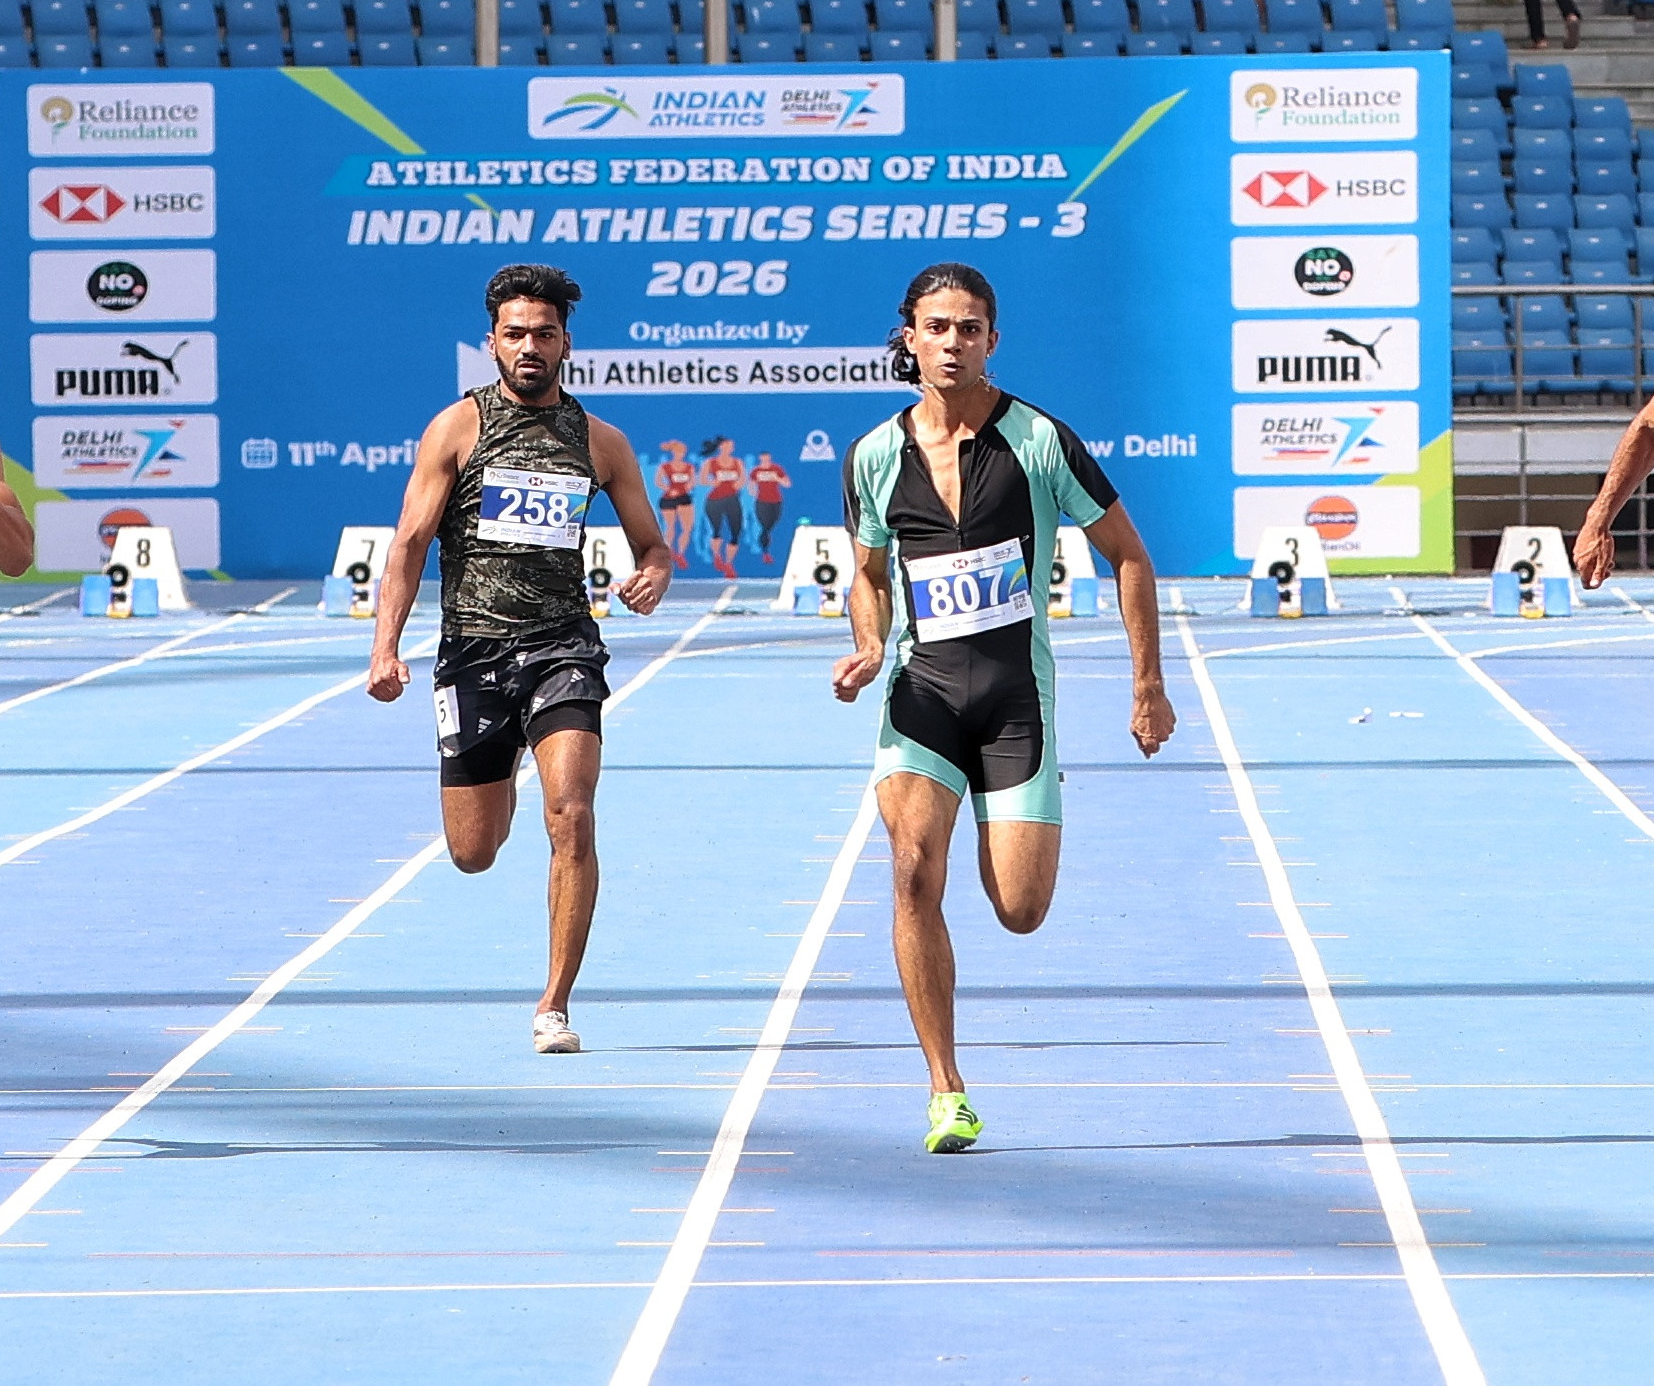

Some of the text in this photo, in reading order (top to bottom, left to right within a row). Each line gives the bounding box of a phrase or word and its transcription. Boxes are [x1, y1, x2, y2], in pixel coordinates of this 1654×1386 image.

[653, 91, 767, 110] INDIAN
[780, 89, 831, 103] DELHI
[1282, 86, 1401, 108] Reliance
[79, 99, 199, 123] Reliance
[649, 112, 766, 127] ATHLETICS
[1281, 109, 1401, 127] Foundation
[79, 123, 198, 141] Foundation
[366, 153, 1068, 187] ATHLETICS FEDERATION OF INDIA
[1336, 179, 1407, 198] HSBC
[133, 193, 205, 214] HSBC
[347, 201, 1088, 246] INDIAN ATHLETICS SERIES - 3
[645, 260, 789, 297] 2026
[1304, 259, 1341, 277] NO
[99, 273, 135, 291] NO
[629, 320, 811, 348] Organized by
[561, 359, 594, 385] lhi
[604, 357, 740, 385] Athletics
[1257, 355, 1361, 383] PUMA
[56, 368, 160, 397] PUMA
[62, 429, 124, 445] DELHI
[1261, 417, 1324, 432] DELHI
[62, 445, 139, 458] ATHLETICS
[1123, 433, 1198, 458] Delhi
[1260, 433, 1338, 446] ATHLETICS
[288, 440, 337, 467] 11th
[498, 488, 569, 528] 258
[136, 538, 151, 568] 8
[361, 538, 375, 565] 7
[592, 538, 607, 568] 6
[816, 538, 830, 565] 5
[1285, 537, 1299, 567] 3
[1528, 537, 1544, 568] 2
[928, 566, 1004, 617] 807
